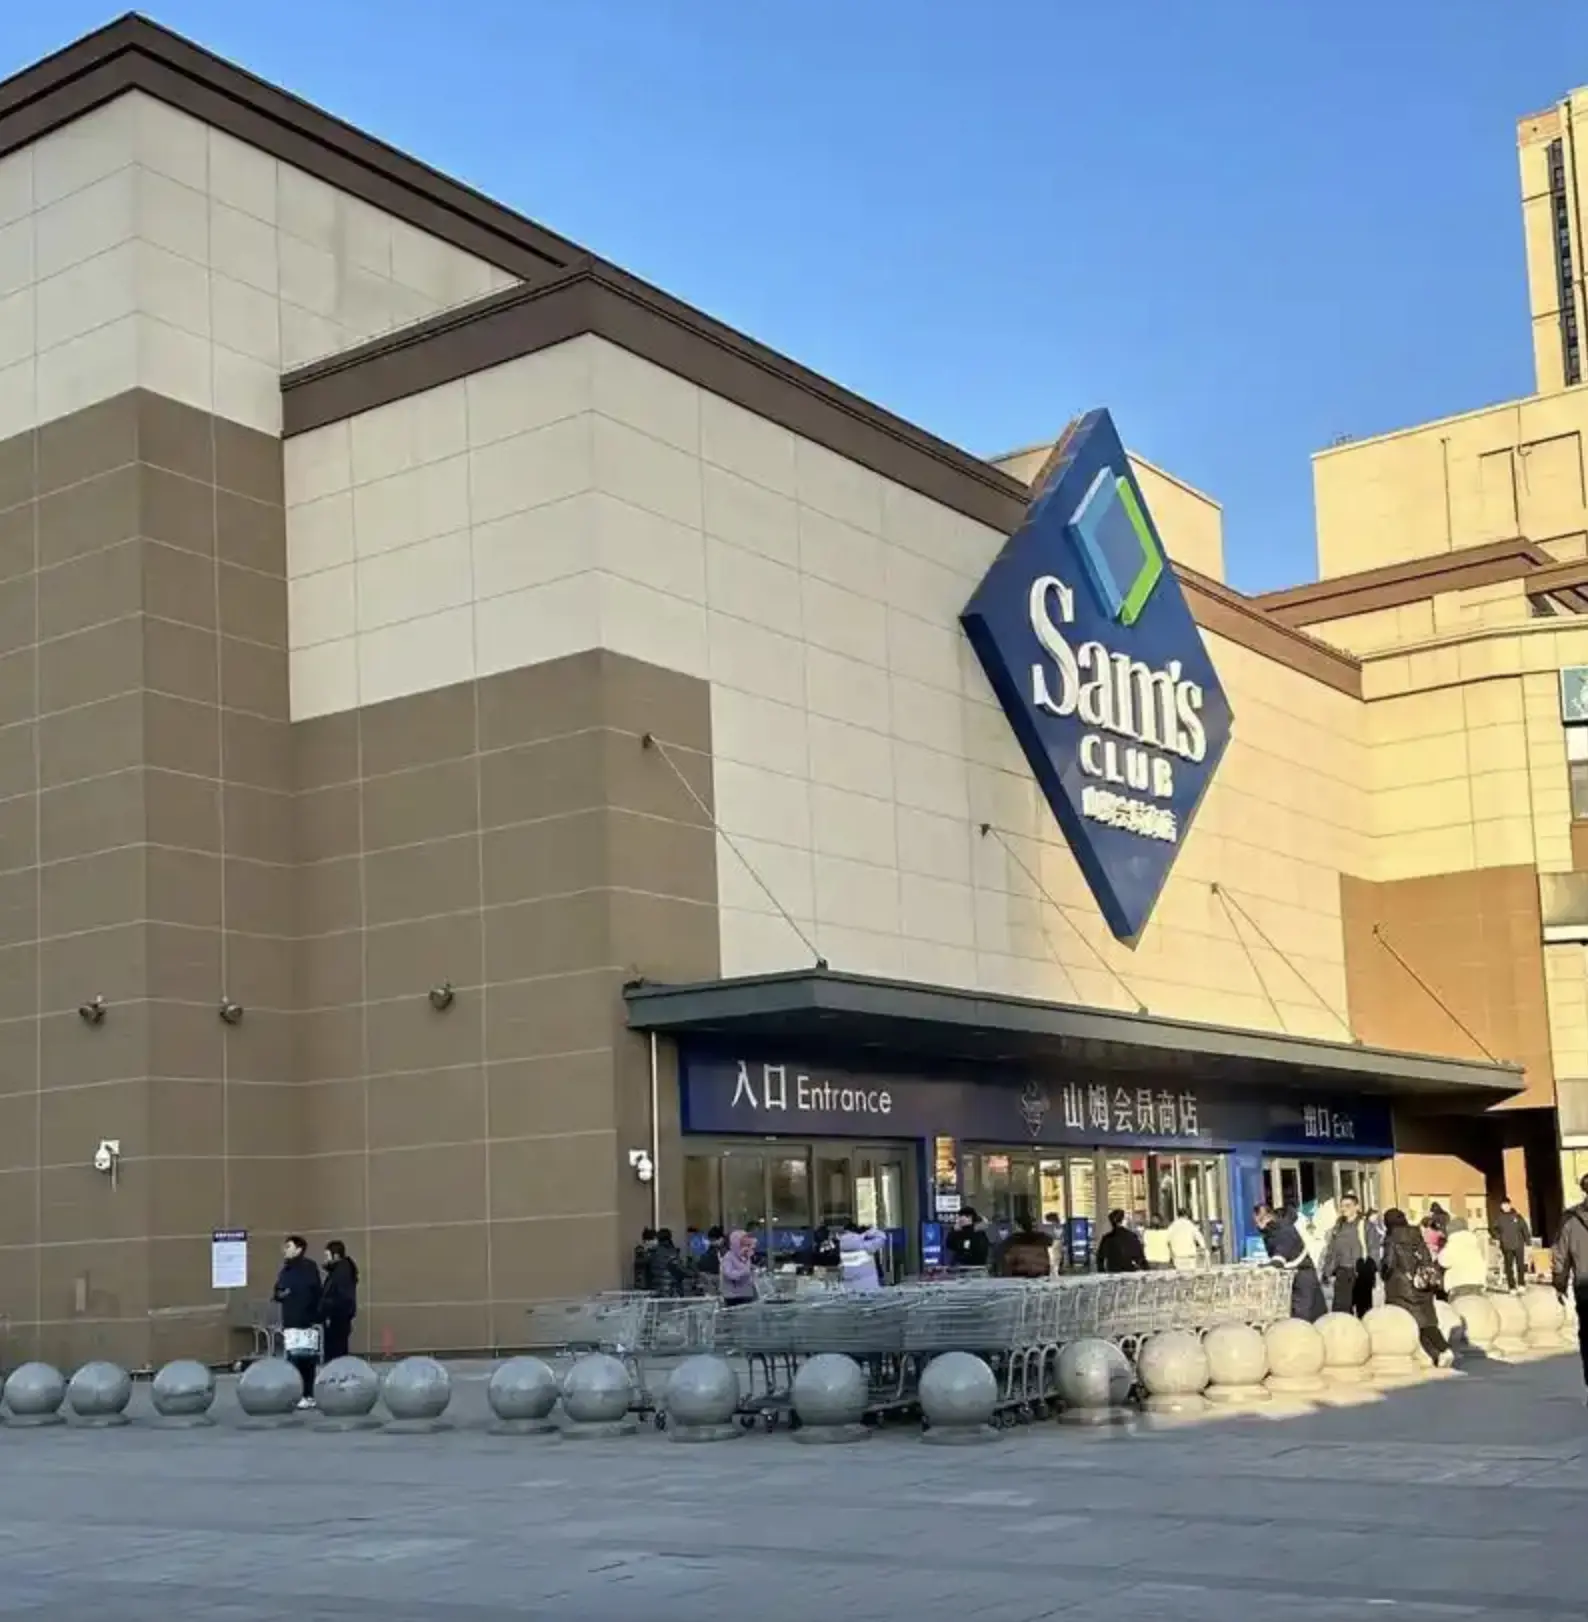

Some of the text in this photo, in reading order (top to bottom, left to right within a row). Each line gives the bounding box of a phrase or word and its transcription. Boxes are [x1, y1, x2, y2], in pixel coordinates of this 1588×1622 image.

[1029, 575, 1207, 763] Sam's
[1080, 734, 1173, 797] CLUB
[731, 1060, 893, 1114] 入口 Entrance
[1062, 1081, 1199, 1137] 山姆会员商店
[1303, 1104, 1355, 1140] 出口 Exit
